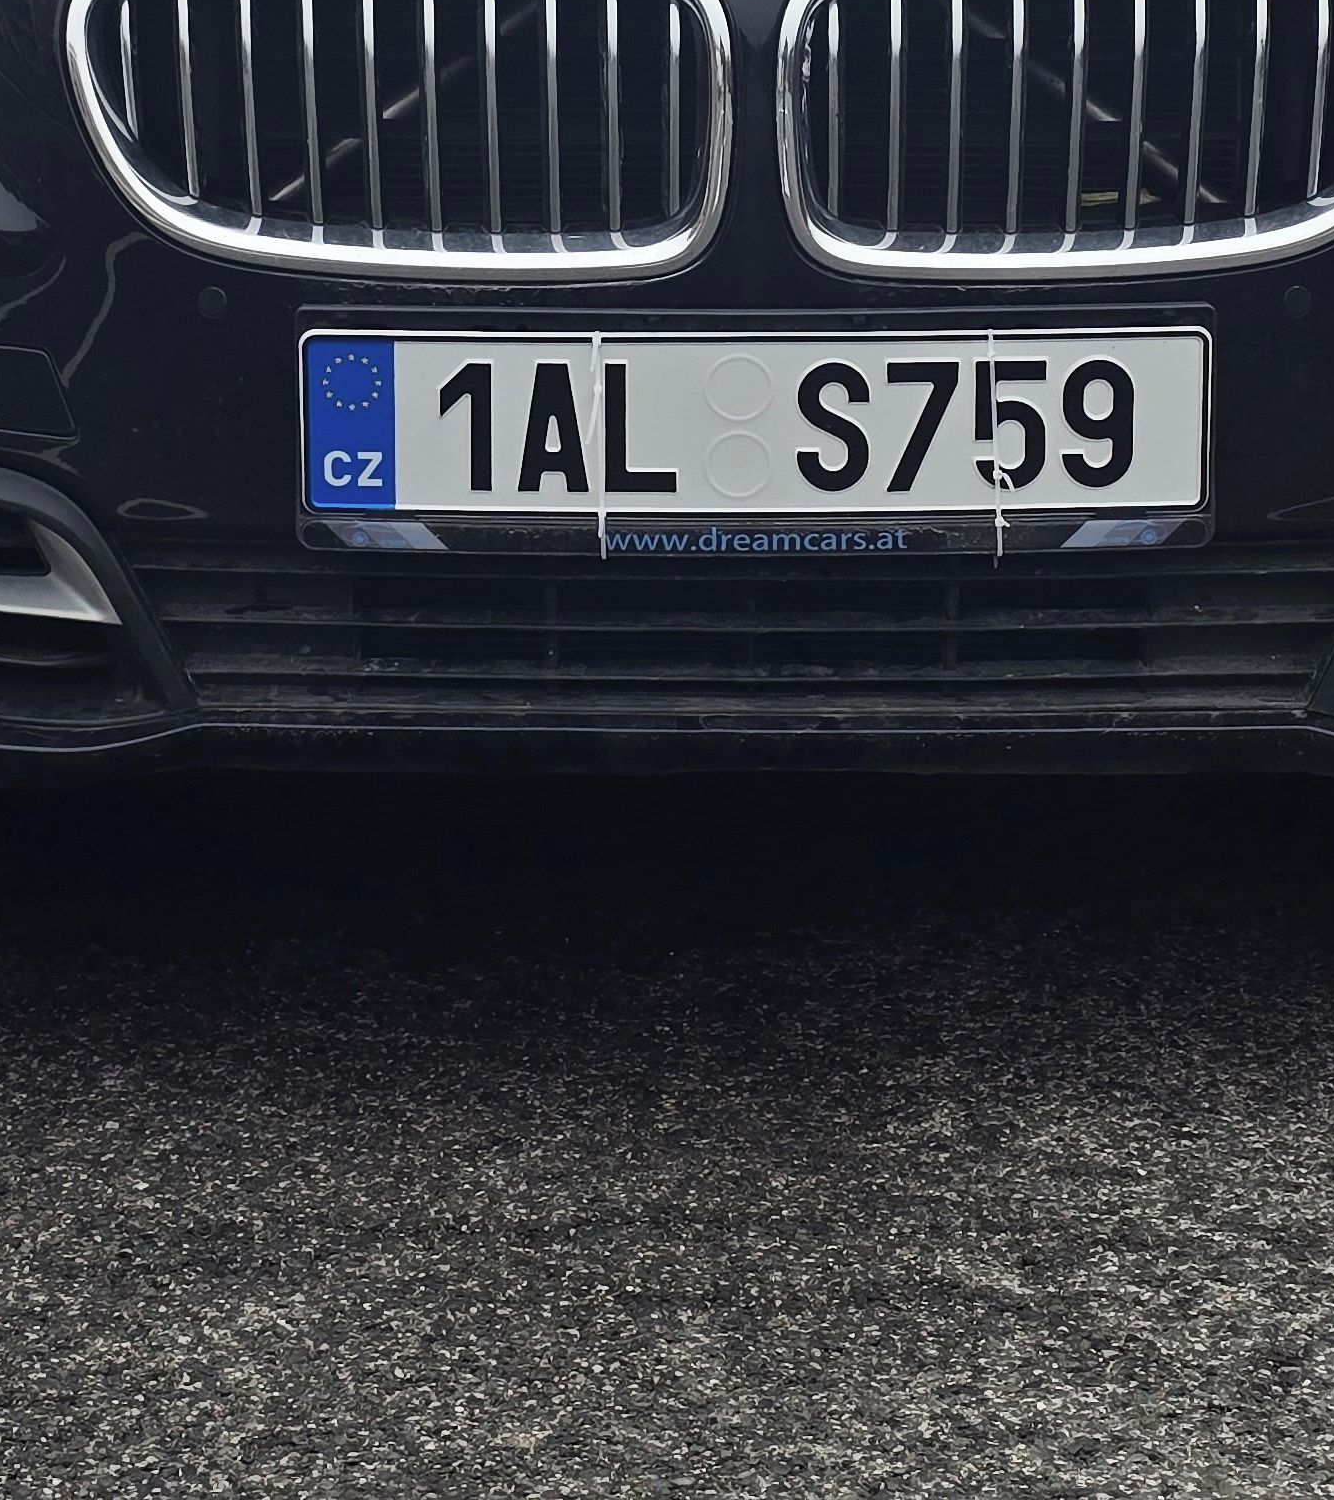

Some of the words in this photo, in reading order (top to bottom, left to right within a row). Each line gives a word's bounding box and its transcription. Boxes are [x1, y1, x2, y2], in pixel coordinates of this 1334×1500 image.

[439, 362, 678, 492] 1AL
[796, 359, 1135, 492] S759
[323, 450, 383, 487] CZ
[605, 527, 908, 551] www.dreamcars.at
